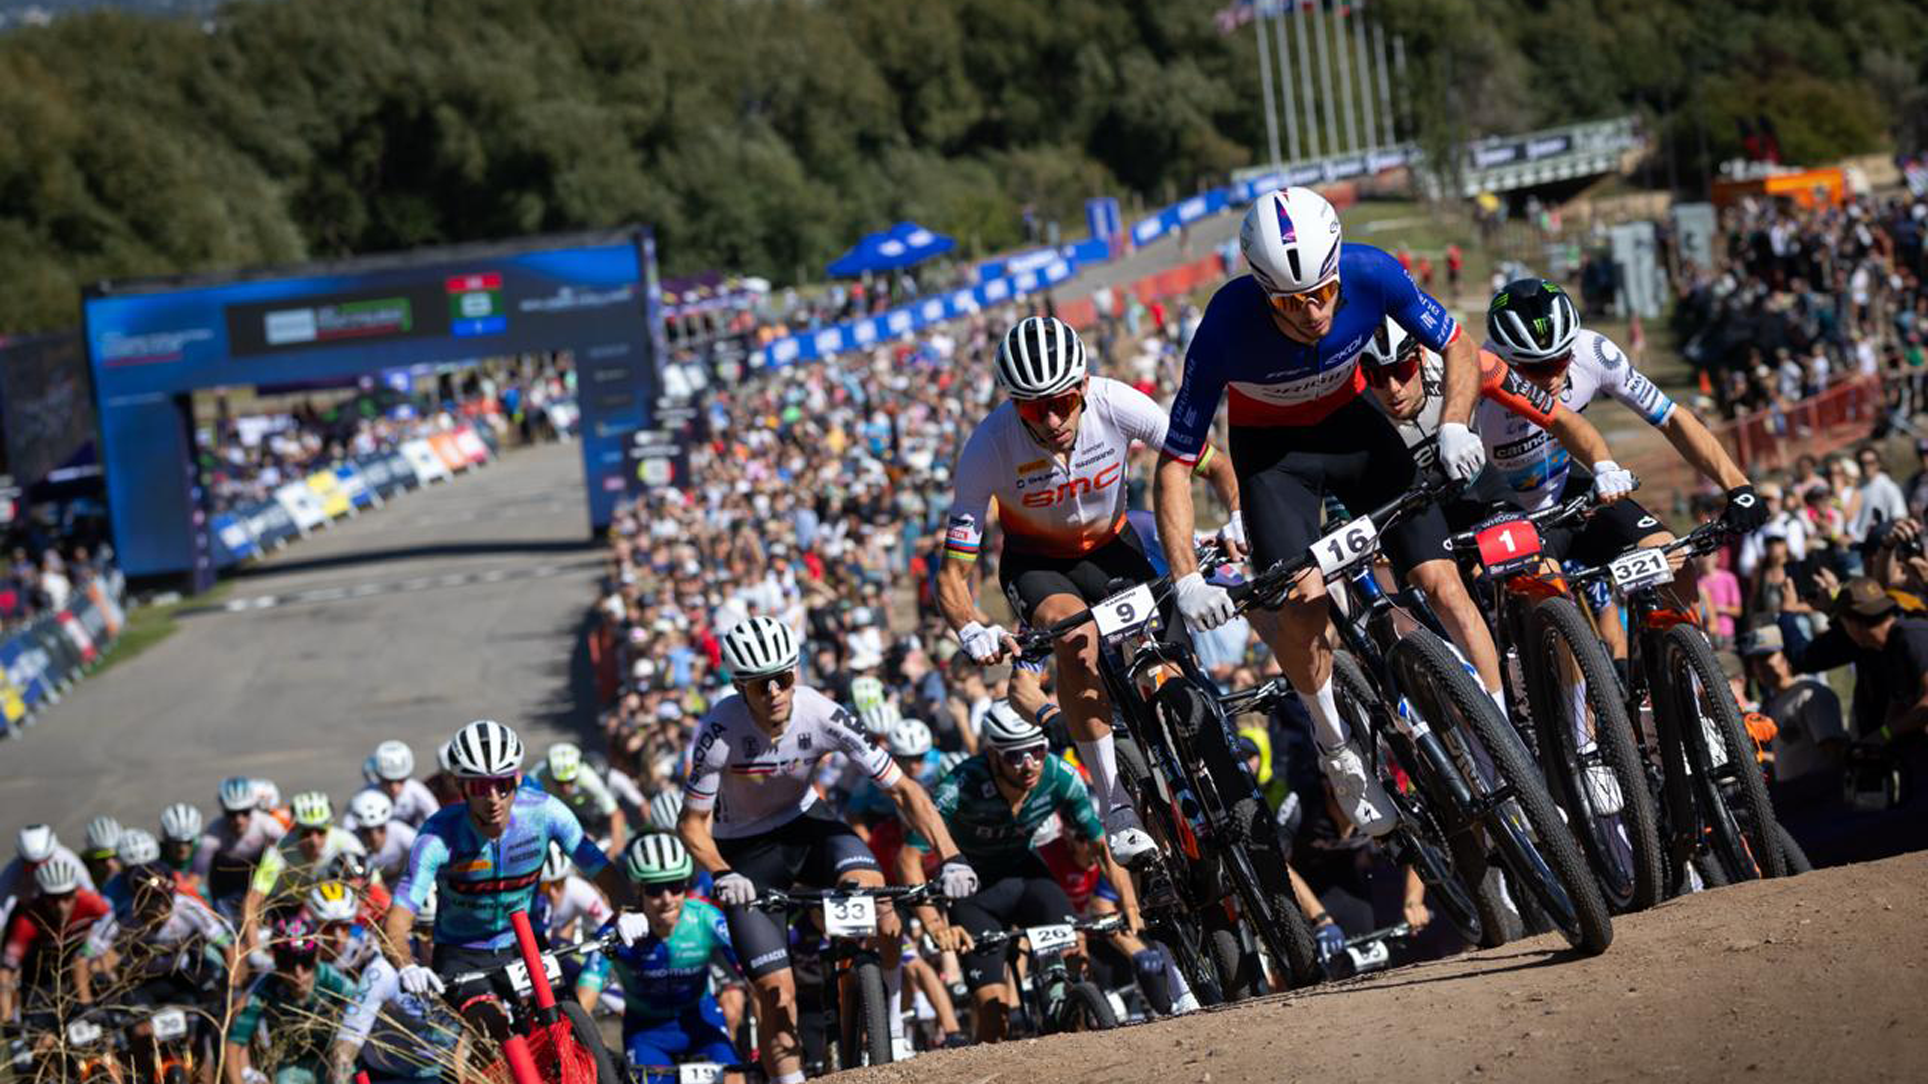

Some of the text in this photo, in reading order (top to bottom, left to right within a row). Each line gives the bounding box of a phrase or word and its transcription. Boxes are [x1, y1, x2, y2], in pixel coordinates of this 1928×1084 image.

[1021, 461, 1120, 509] BMC
[1480, 513, 1520, 527] WHOOP
[1326, 528, 1370, 562] 16
[1499, 529, 1516, 552] 1
[1615, 555, 1662, 580] 321
[1115, 602, 1136, 624] 9
[833, 903, 866, 921] 33
[1037, 927, 1068, 943] 26
[691, 1067, 718, 1081] 19
